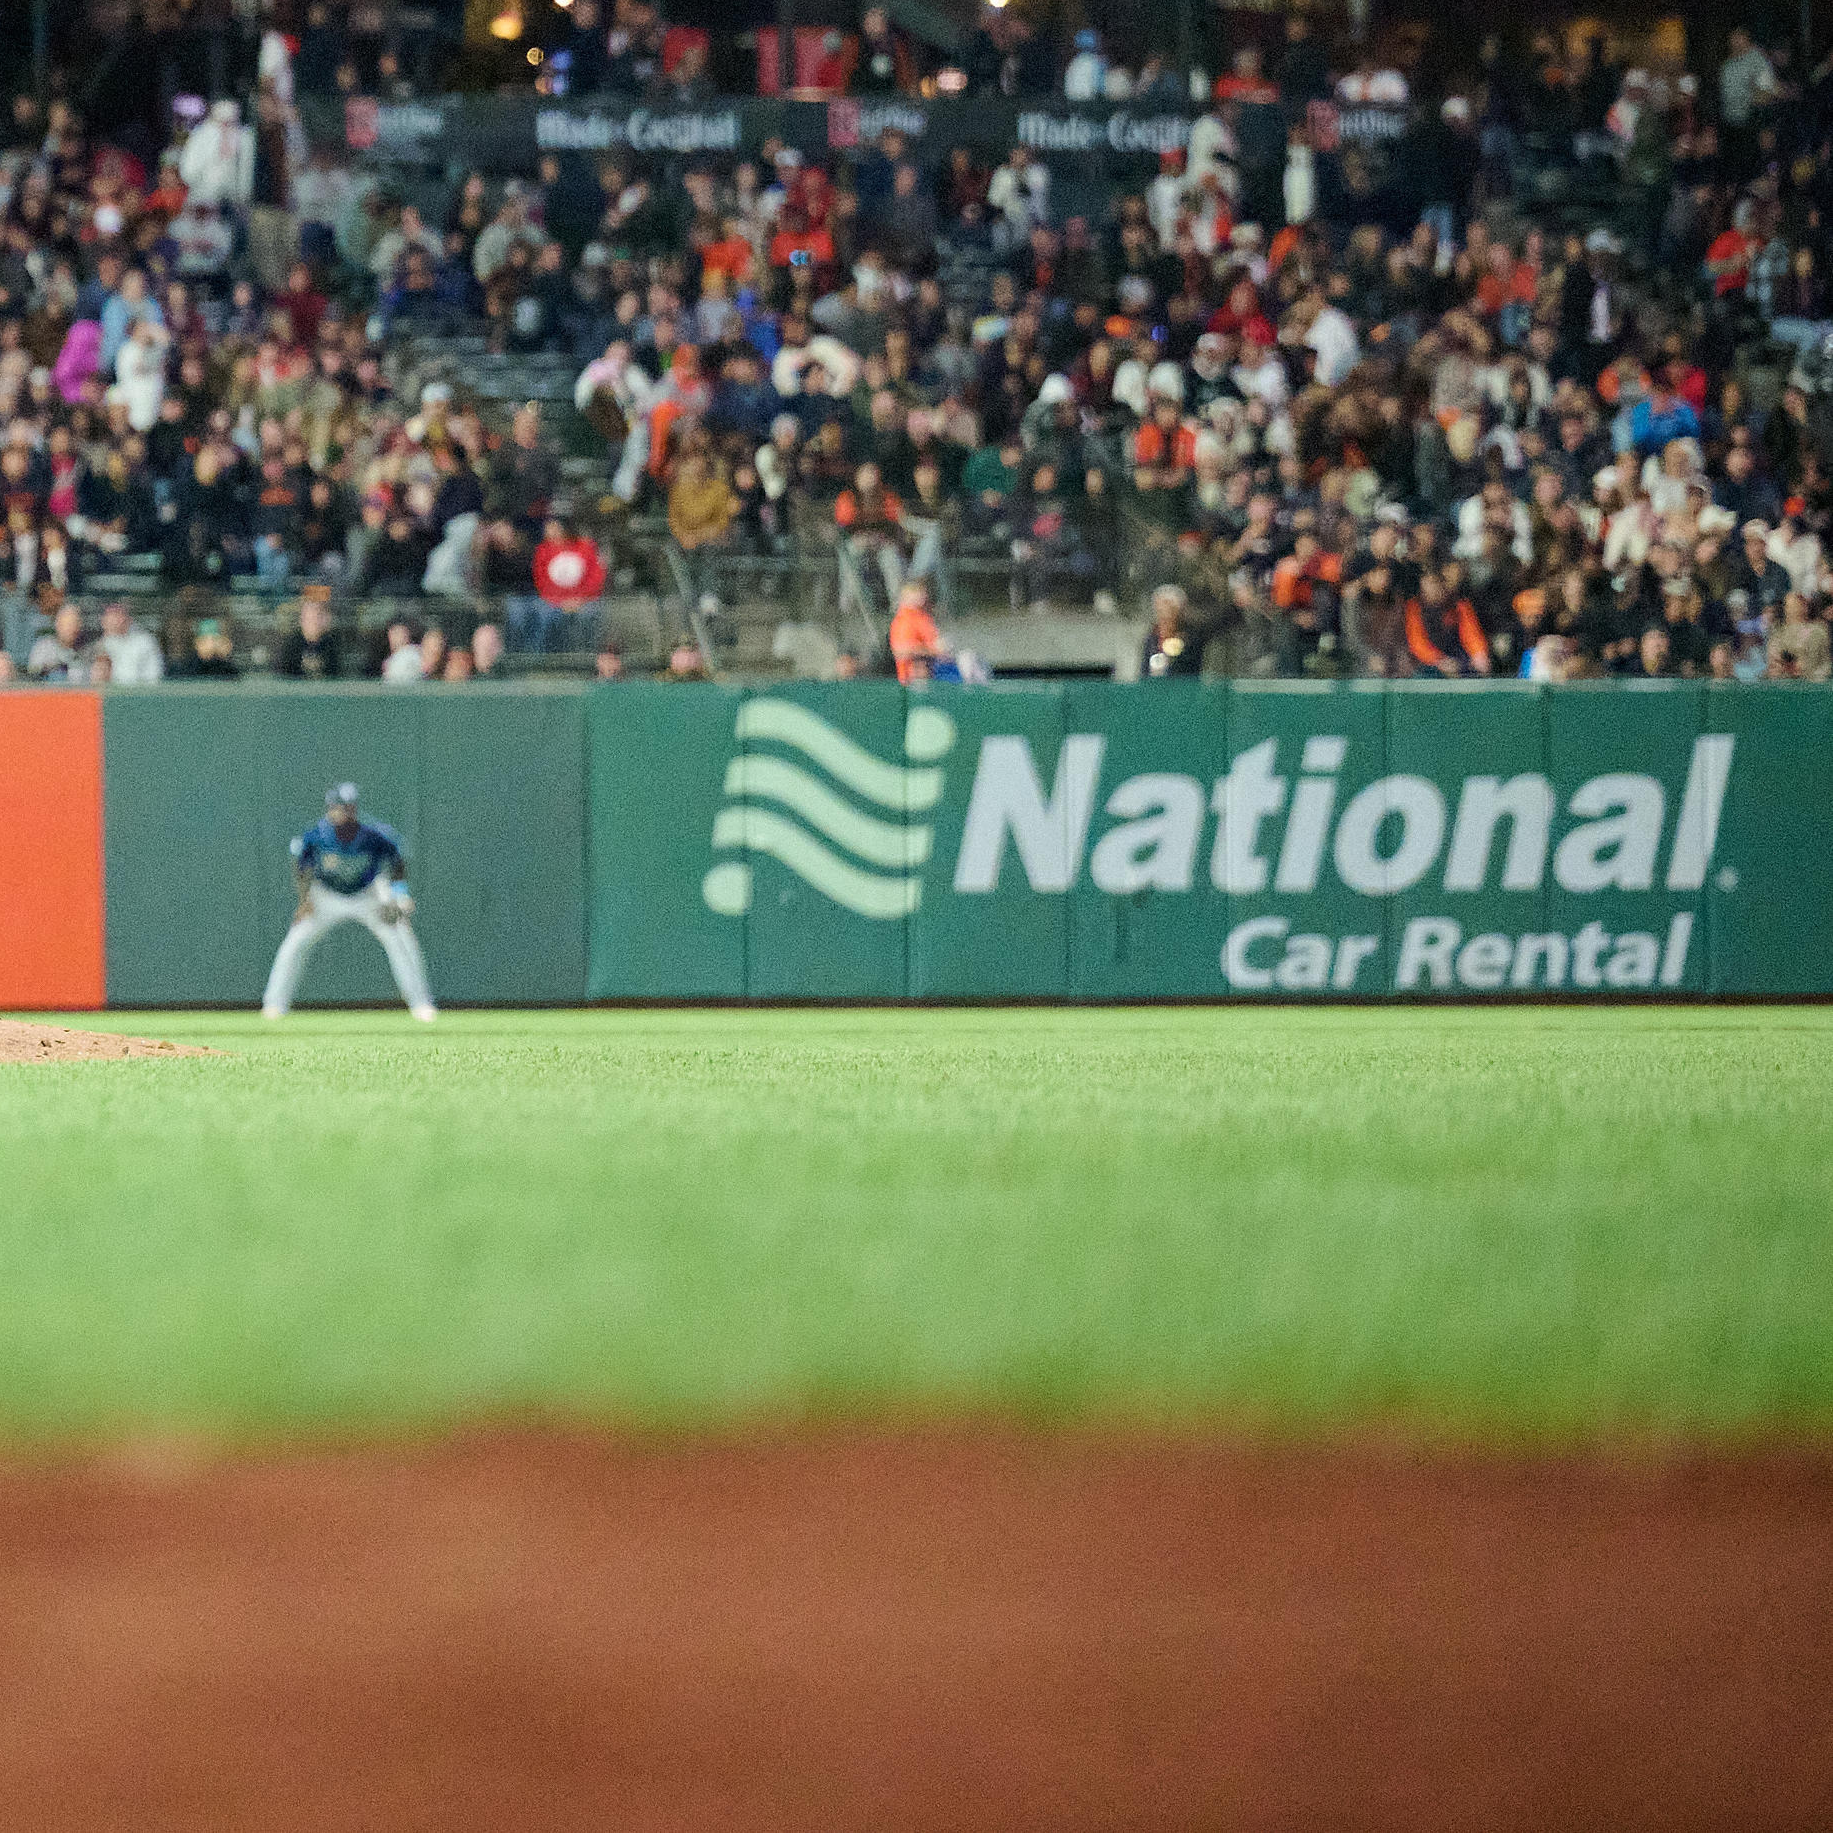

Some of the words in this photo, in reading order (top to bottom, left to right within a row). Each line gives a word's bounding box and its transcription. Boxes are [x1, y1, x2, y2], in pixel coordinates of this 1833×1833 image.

[952, 733, 1737, 895] National
[1220, 916, 1377, 992] Car
[1394, 911, 1695, 992] Rental
